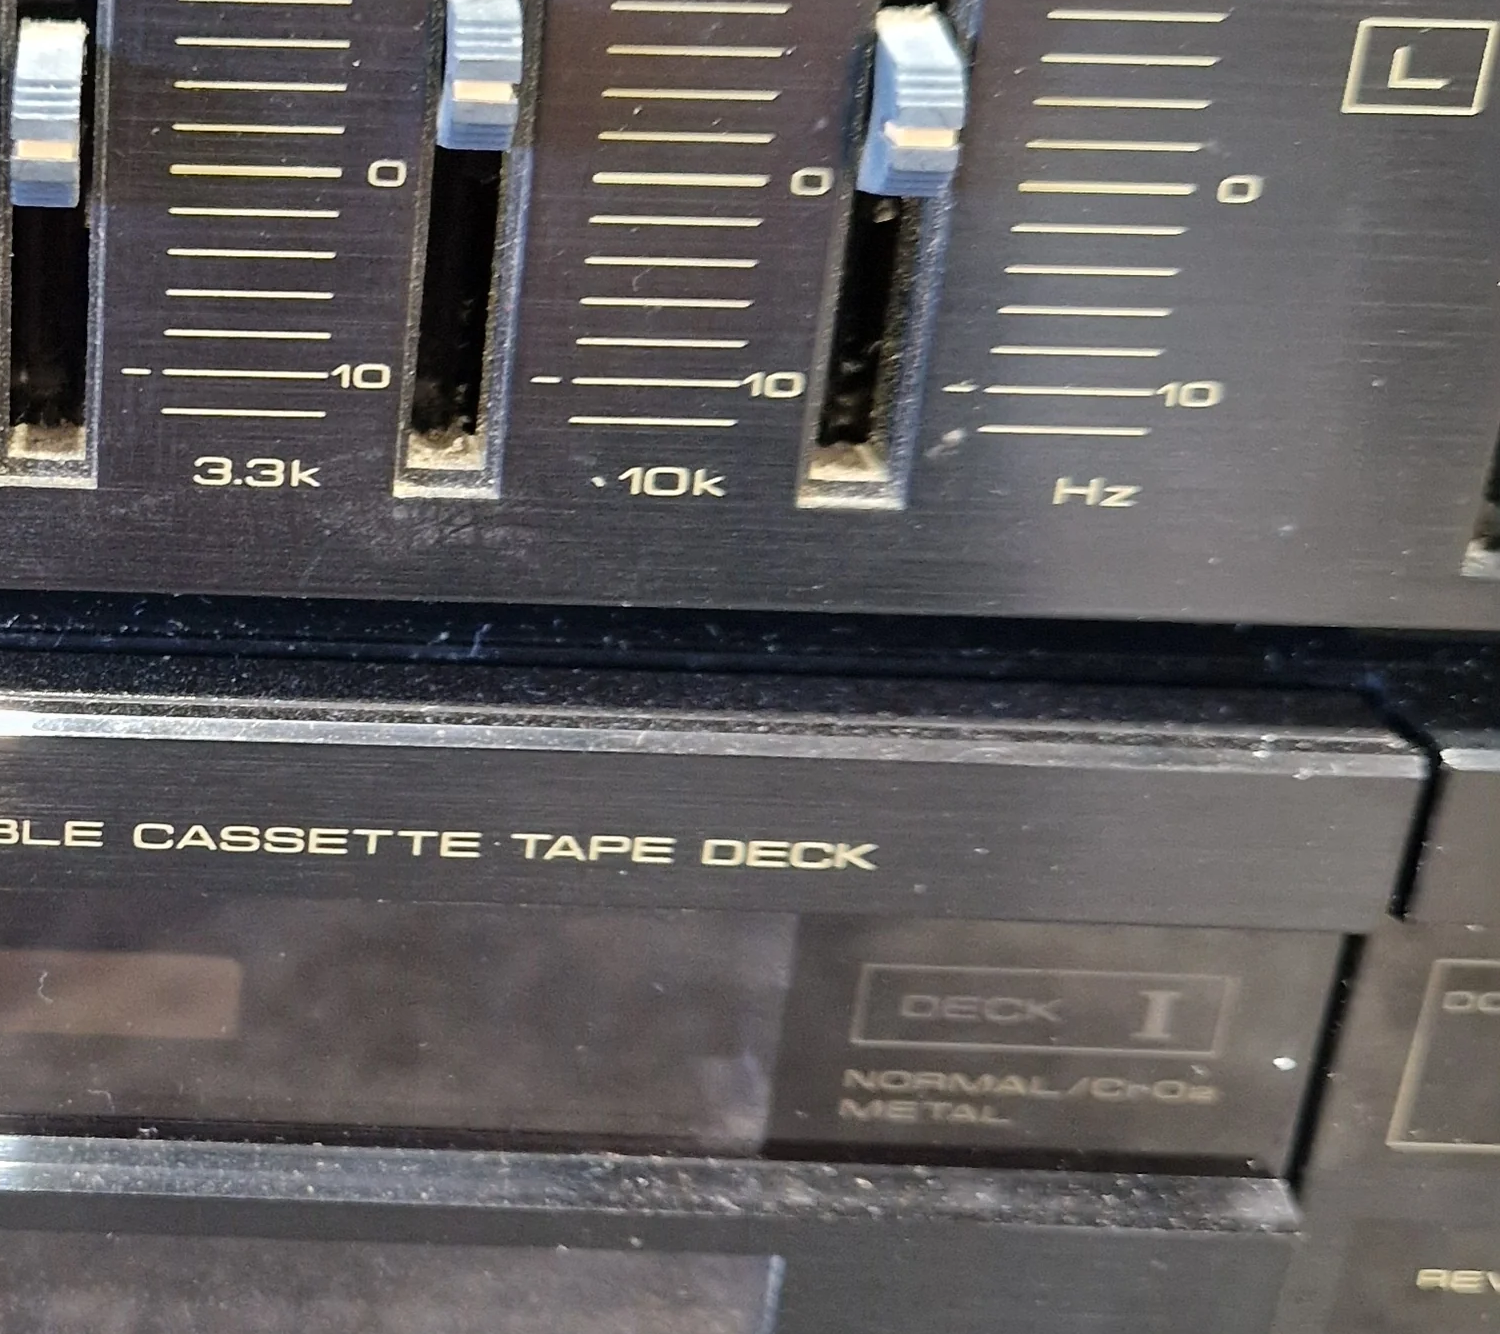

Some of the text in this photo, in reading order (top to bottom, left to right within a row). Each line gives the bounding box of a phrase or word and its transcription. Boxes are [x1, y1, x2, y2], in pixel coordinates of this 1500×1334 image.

[1387, 46, 1449, 90] L
[367, 158, 408, 188] 0
[790, 167, 834, 196] 0
[1216, 174, 1263, 204] 0
[330, 362, 391, 389] 10
[741, 370, 806, 399] 10
[1155, 379, 1223, 409] 10
[192, 456, 321, 488] 3.3k
[618, 466, 725, 497] 10k
[1052, 477, 1140, 507] Hz
[132, 822, 483, 858] CASSETTE
[510, 833, 677, 864] TAPE
[701, 838, 878, 870] DECK
[900, 993, 1065, 1024] DECK
[838, 1098, 1013, 1126] METAL
